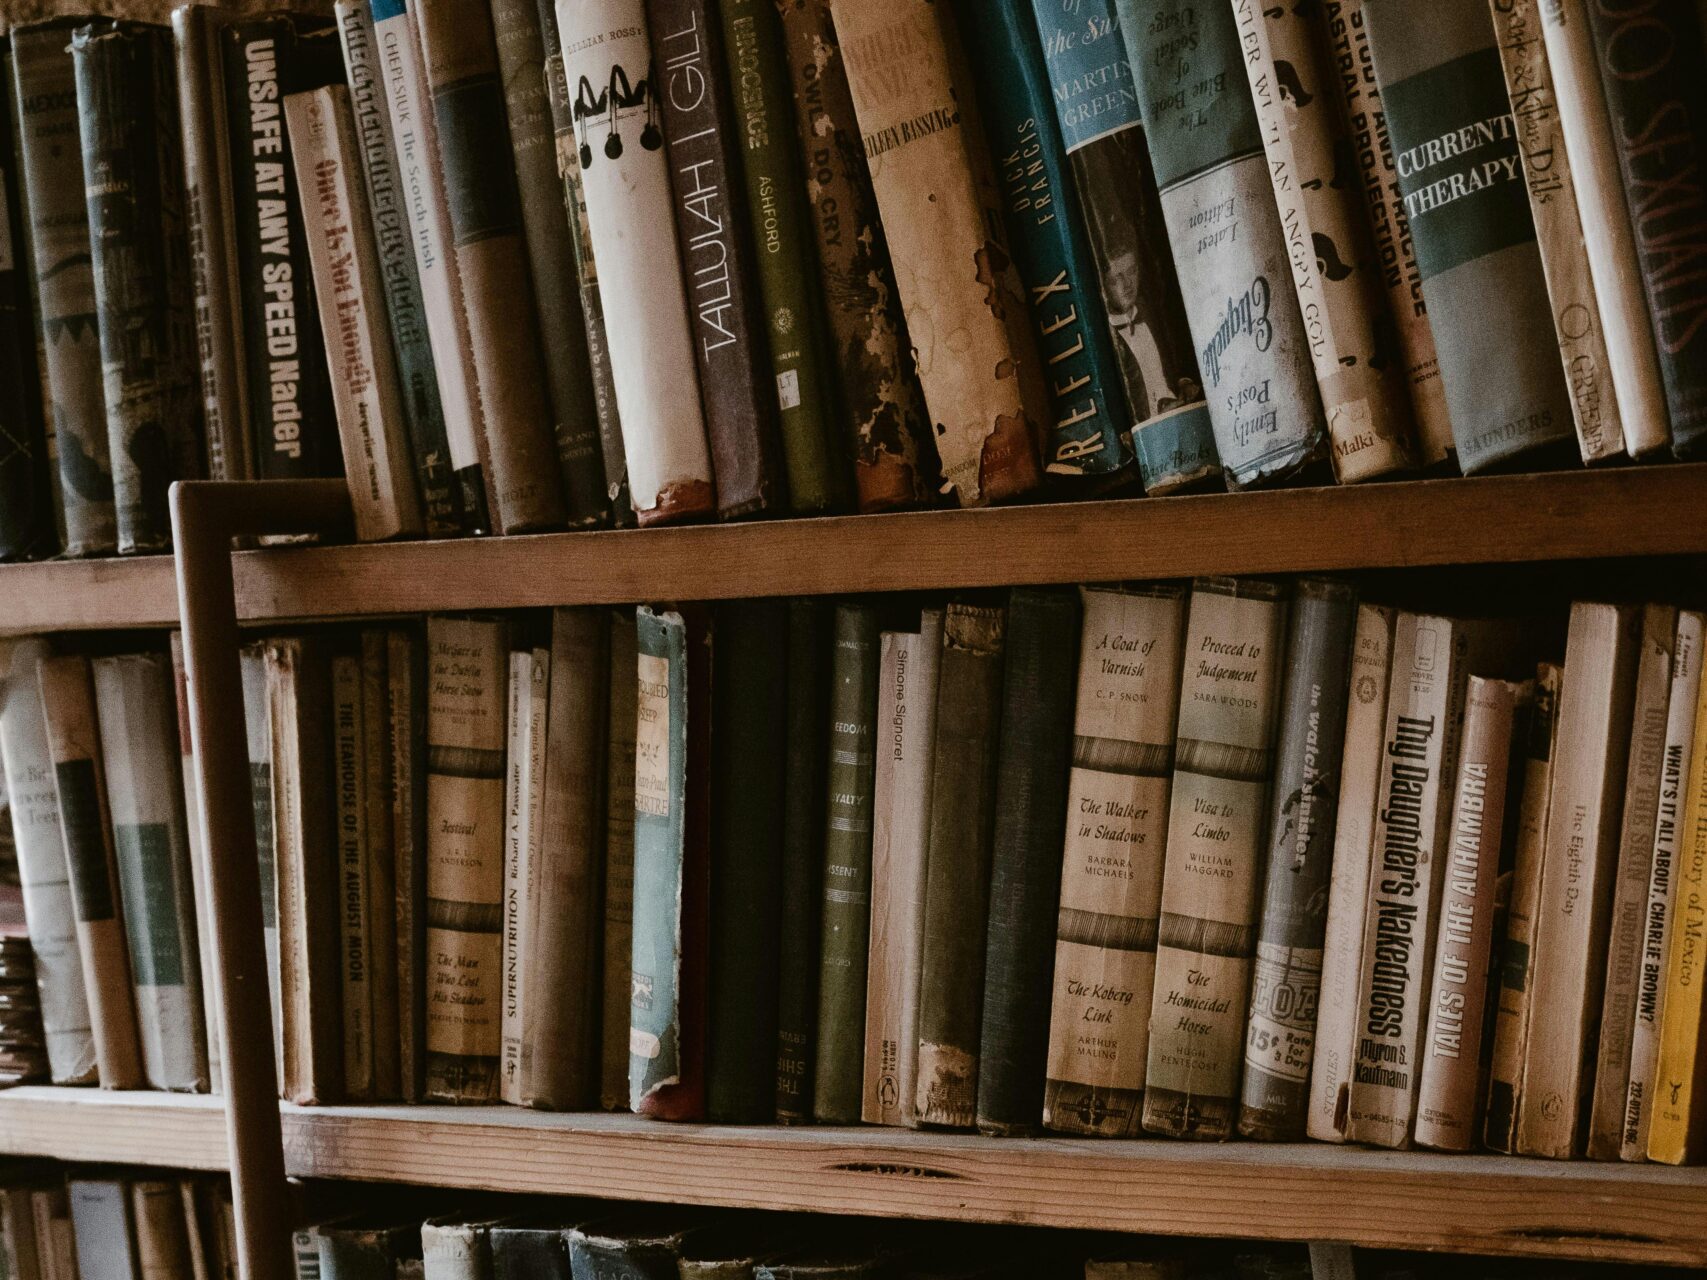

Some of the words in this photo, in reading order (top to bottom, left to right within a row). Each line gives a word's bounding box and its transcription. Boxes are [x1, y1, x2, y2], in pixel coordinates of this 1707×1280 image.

[567, 33, 604, 55] LILLIAN
[609, 27, 642, 40] ROSS:
[663, 10, 706, 112] GILL
[244, 39, 283, 157] UNSAFE
[383, 31, 411, 122] CHEPESIUK
[402, 130, 416, 161] The
[1327, 2, 1360, 108] ASTRAL
[1352, 113, 1402, 289] PROJECTION
[1397, 114, 1517, 178] CURRENT
[254, 162, 287, 194] AT
[315, 159, 341, 217] Once
[1006, 150, 1030, 213] DICK
[1018, 117, 1054, 226] FRANCIS
[1404, 154, 1523, 221] THERAPY
[257, 199, 291, 256] ANY
[325, 225, 348, 250] Is
[758, 176, 781, 254] ASHFORD
[1188, 197, 1237, 228] Edition
[1198, 222, 1239, 254] Latest
[329, 252, 354, 295] Not
[680, 159, 737, 363] TALLULAH
[262, 262, 298, 357] SPEED
[1202, 275, 1272, 388] Etiquette
[337, 298, 371, 396] Enough
[1032, 269, 1106, 461] REFLEX
[269, 360, 302, 460] Nader
[1232, 409, 1278, 446] Emily
[1463, 410, 1554, 456] SAUNDERS
[1336, 431, 1375, 457] Malki
[1096, 634, 1108, 651] A
[1112, 635, 1138, 652] Coat
[1142, 639, 1156, 655] of
[1101, 659, 1145, 678] Varnish
[897, 650, 908, 700] Simone
[1194, 692, 1217, 704] SARA
[1221, 696, 1258, 709] WOODS
[340, 703, 354, 728] THE
[893, 704, 907, 762] Signoret
[1388, 714, 1435, 761] Thy
[341, 736, 357, 809] TEAHOUSE
[510, 764, 521, 817] Passwater
[1662, 745, 1683, 800] WHAT'S
[343, 814, 357, 832] OF
[1079, 822, 1091, 838] in
[1095, 824, 1147, 843] Shadows
[1080, 798, 1102, 815] The
[1105, 801, 1148, 820] Walker
[1379, 762, 1430, 894] Daughter's
[1449, 762, 1488, 897] ALHAMBRA
[1657, 820, 1675, 844] ALL
[1661, 802, 1676, 817] IT
[345, 839, 359, 864] THE
[509, 836, 519, 880] Richard
[1085, 867, 1134, 880] MICHAELS
[1651, 848, 1672, 899] ABOUT,
[346, 871, 362, 930] AUGUST
[1445, 902, 1474, 946] THE
[507, 889, 518, 1018] SUPERNUTRITION
[1646, 903, 1665, 961] CHARLIE
[349, 935, 364, 982] MOON
[1367, 900, 1418, 1038] Nakedness
[1447, 953, 1470, 985] OF
[1067, 980, 1089, 996] The
[1091, 983, 1133, 1005] Koberg
[1082, 1007, 1113, 1025] Link
[1639, 964, 1661, 1024] BROWN?
[1432, 989, 1466, 1060] TALES
[1354, 1064, 1408, 1090] Kaufmann
